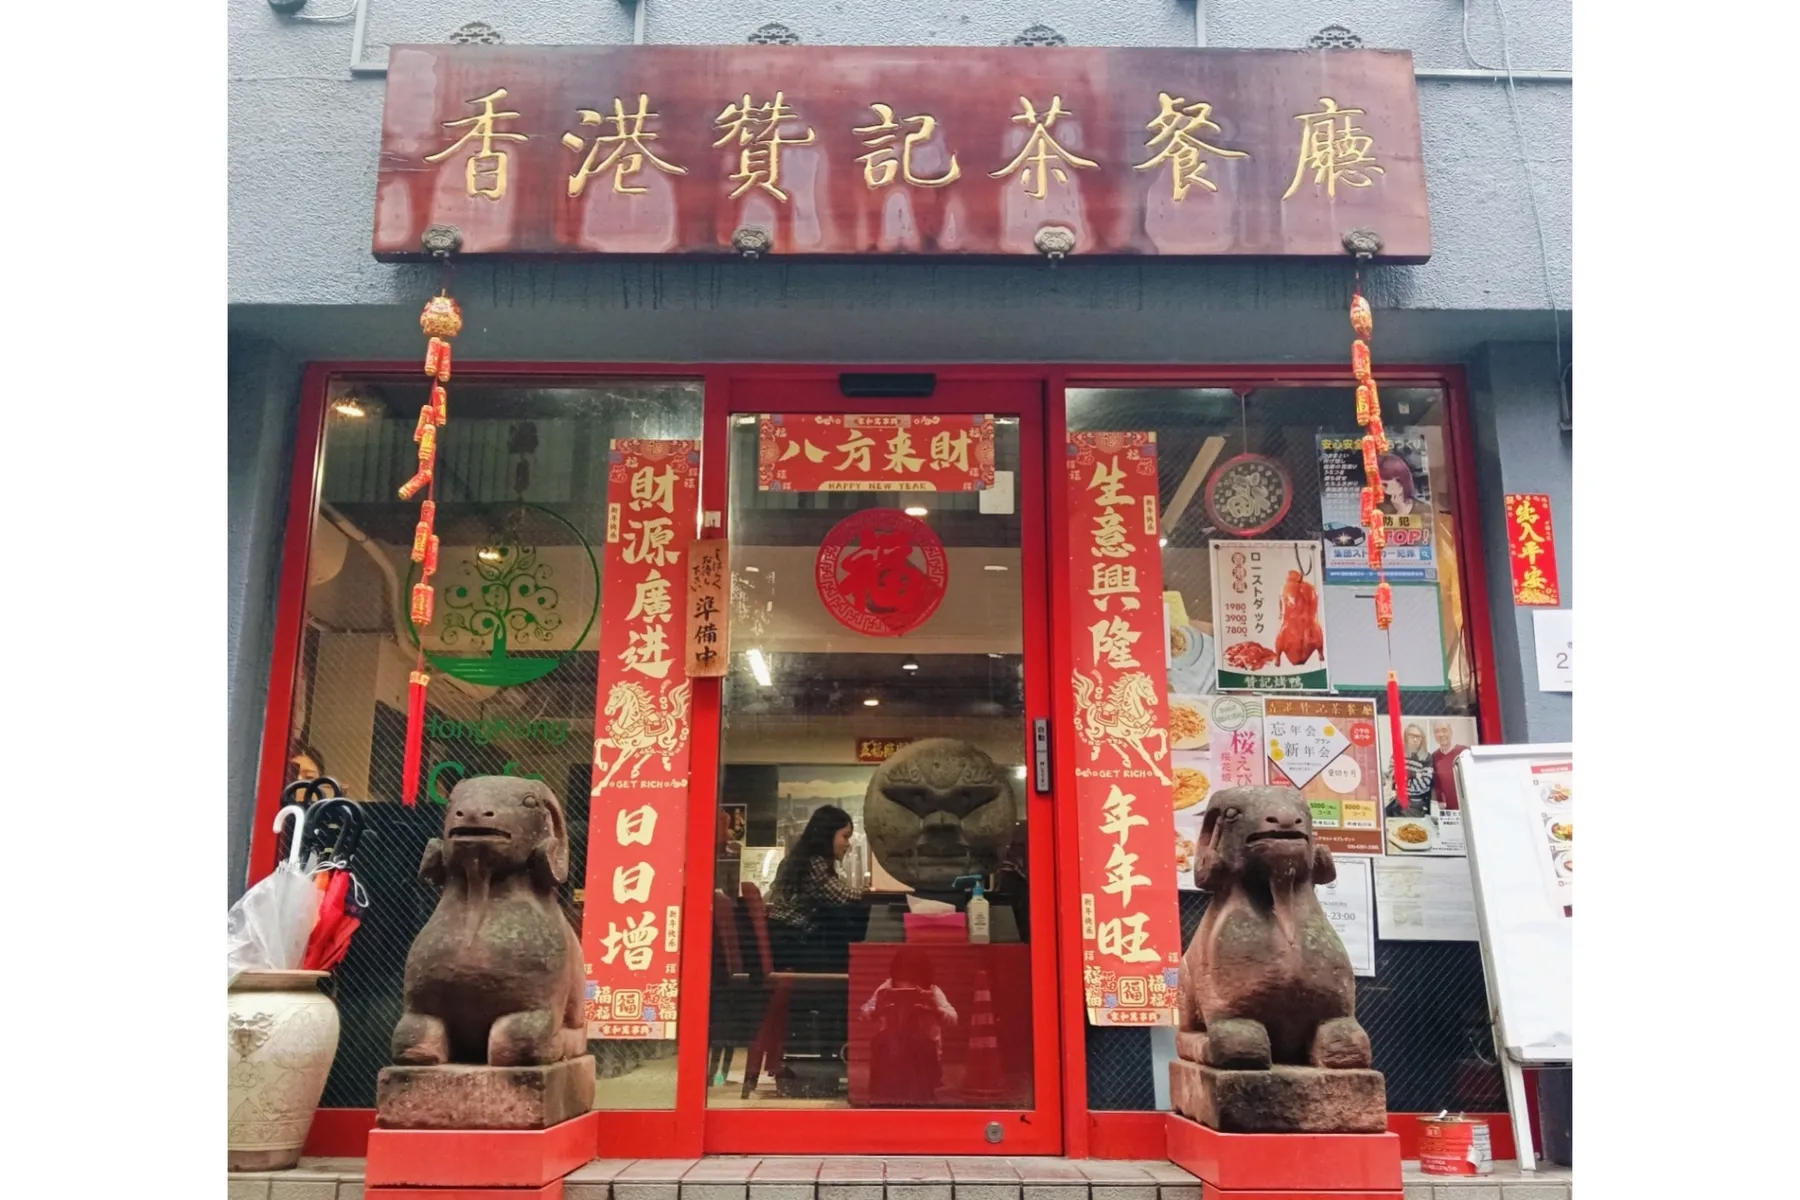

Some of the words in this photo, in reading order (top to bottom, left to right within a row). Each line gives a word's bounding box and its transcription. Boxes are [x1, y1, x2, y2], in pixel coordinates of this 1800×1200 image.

[1384, 529, 1429, 545] TOP!
[1333, 549, 1416, 559] 集団ストカー犯罪
[1251, 552, 1264, 634] ローストダック
[1225, 603, 1246, 611] 1980
[1225, 614, 1247, 622] 3900
[693, 596, 720, 667] 準備中
[1226, 626, 1248, 634] 7800
[1099, 769, 1120, 778] GET
[1123, 770, 1146, 778] RICH
[617, 781, 637, 789] GET
[640, 781, 663, 789] RICH
